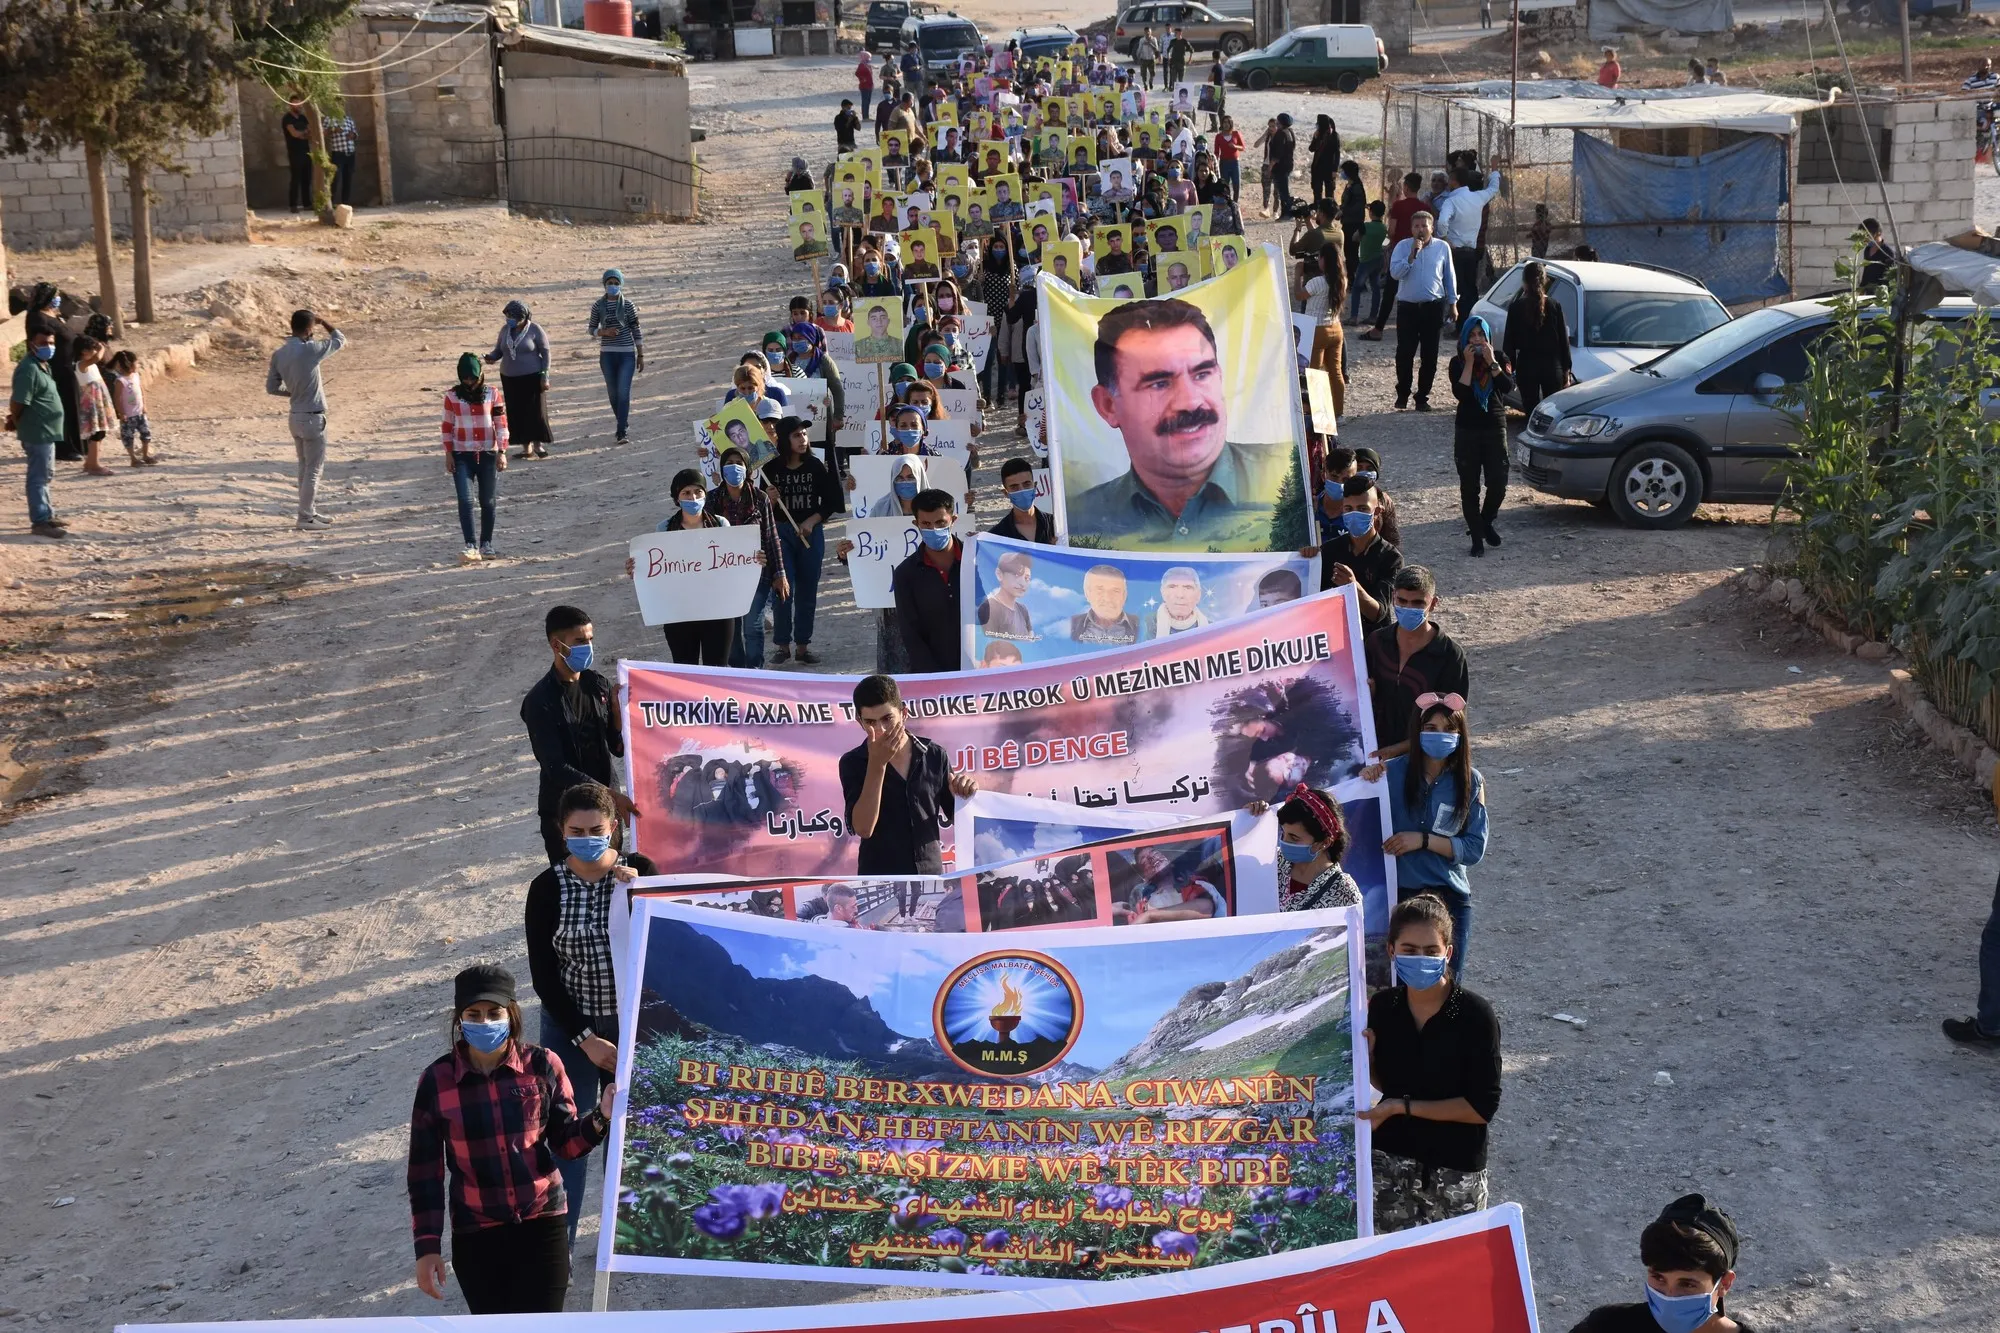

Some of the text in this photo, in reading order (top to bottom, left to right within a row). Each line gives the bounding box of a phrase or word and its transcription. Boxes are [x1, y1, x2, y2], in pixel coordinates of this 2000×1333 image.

[779, 494, 812, 510] IME
[648, 547, 702, 578] Bimire
[745, 703, 792, 724] AXA
[798, 703, 833, 722] ME
[980, 684, 1064, 713] ZAROK
[1071, 675, 1089, 699] Û
[1206, 650, 1242, 677] ME
[983, 741, 1019, 769] BÊ
[1026, 732, 1127, 765] DENGE
[1124, 775, 1210, 803] تركيا
[767, 809, 843, 839] وكبارنا
[982, 1050, 1028, 1065] M.M.Ş
[677, 1059, 1316, 1109] BI RIHÊ BERXWEDANA CIWANÊN
[1090, 1116, 1155, 1144] WÊ
[1164, 1117, 1318, 1144] RIZGAR
[858, 1147, 1028, 1184] FAŞÎZME
[1037, 1152, 1102, 1185] WÊ
[1110, 1153, 1191, 1186] TÊK
[1198, 1153, 1291, 1186] BIBÊ
[781, 1186, 885, 1214] حفتانين
[905, 1192, 1015, 1222] الشهداء
[1020, 1197, 1076, 1229] ابناء
[1080, 1196, 1173, 1230] مقاومة
[1177, 1207, 1234, 1234] بروح
[849, 1235, 960, 1266] ستنتهي
[968, 1234, 1076, 1266] الفاشية
